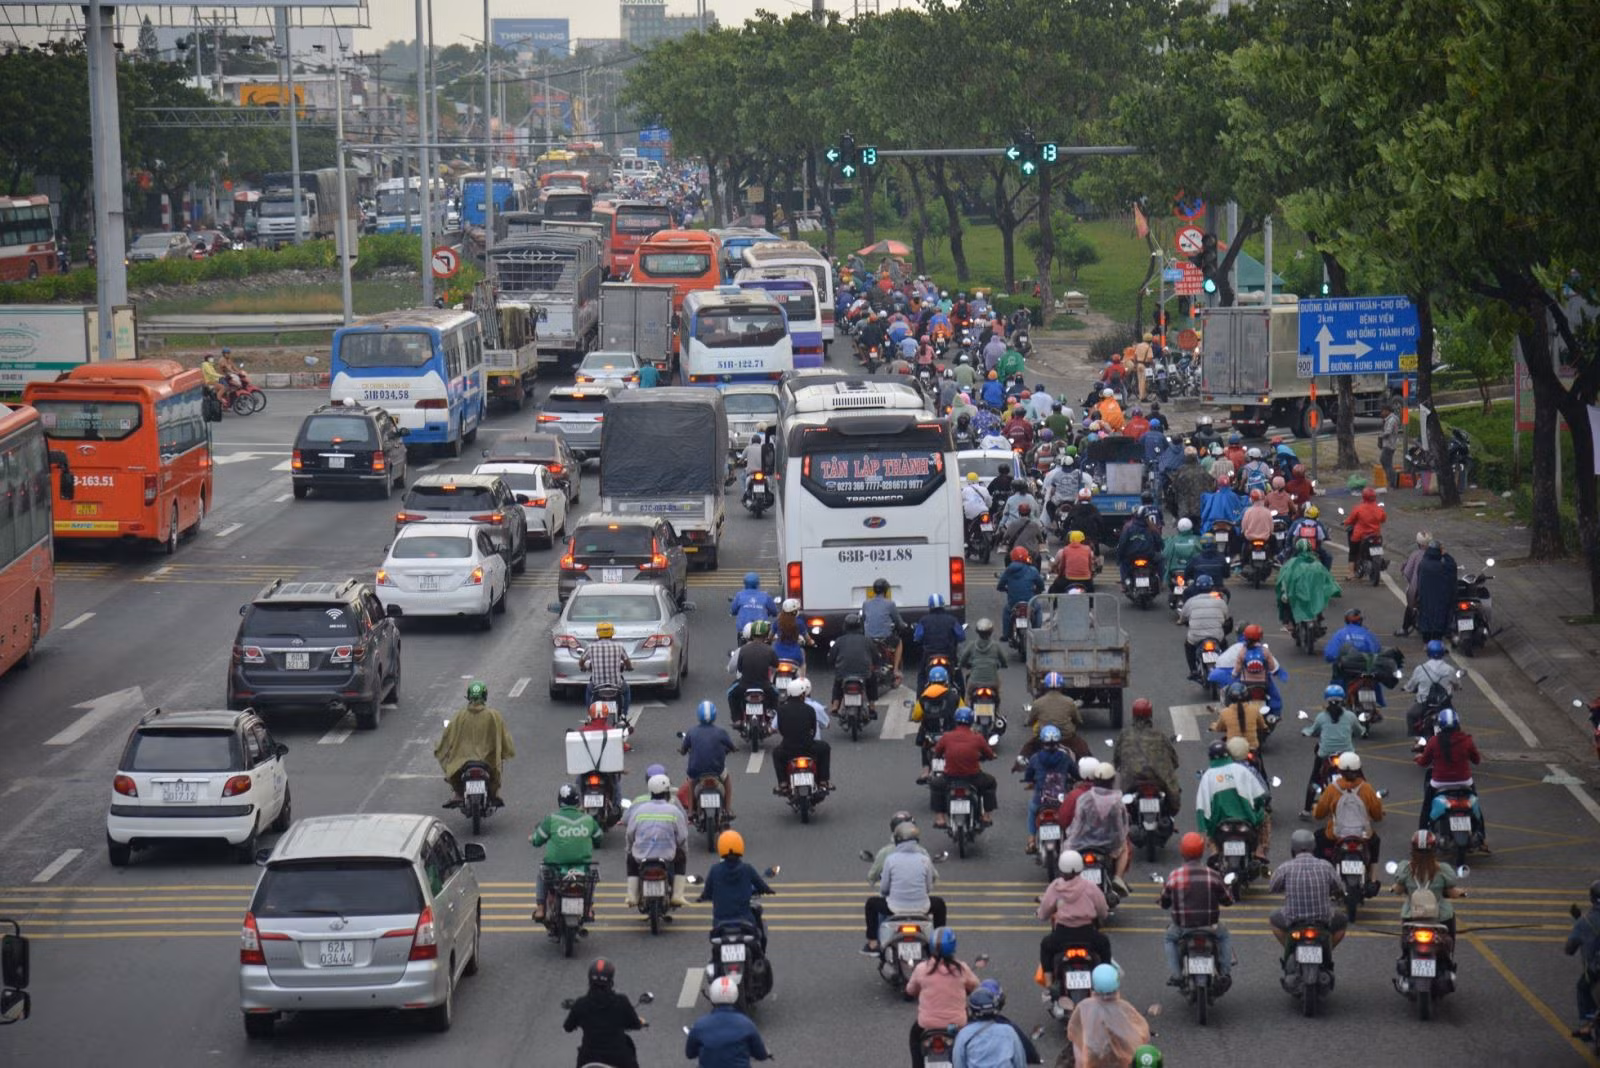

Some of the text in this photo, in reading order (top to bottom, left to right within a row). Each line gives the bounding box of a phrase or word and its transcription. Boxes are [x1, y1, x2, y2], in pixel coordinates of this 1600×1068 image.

[863, 148, 876, 164] 13
[1043, 145, 1056, 161] 13
[821, 456, 848, 479] TÂN
[883, 452, 929, 476] THÀNH
[838, 548, 912, 563] 63B-021.88
[557, 825, 589, 838] Grab
[327, 942, 346, 953] 62A
